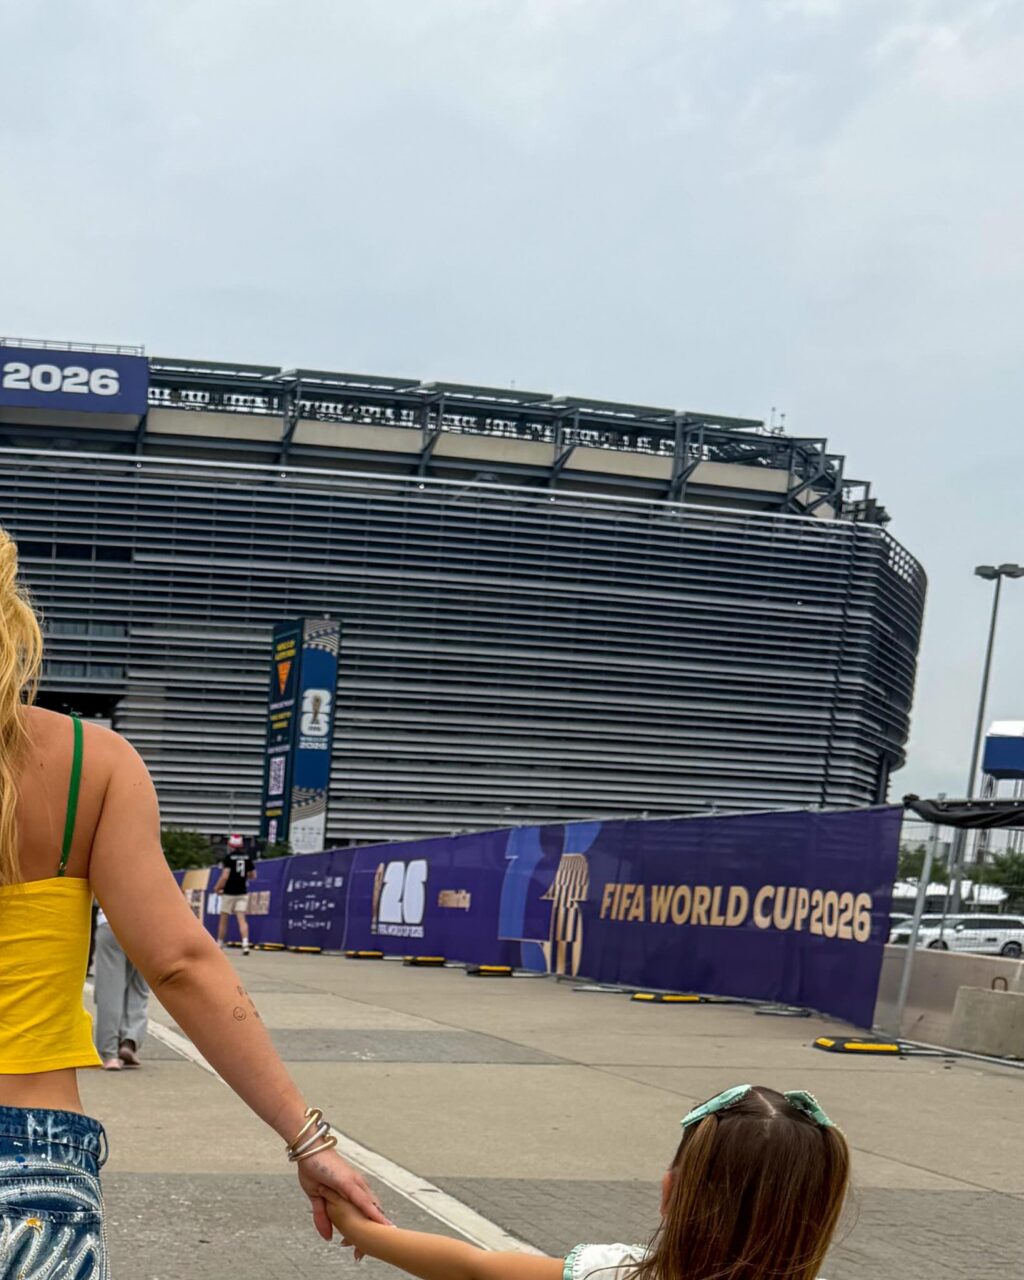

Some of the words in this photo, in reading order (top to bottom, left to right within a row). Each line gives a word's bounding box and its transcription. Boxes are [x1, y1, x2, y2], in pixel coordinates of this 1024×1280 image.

[2, 362, 121, 396] 2026
[378, 859, 428, 925] 26
[600, 883, 645, 922] FIFA
[651, 885, 749, 927] WORLD
[810, 889, 873, 943] 2026
